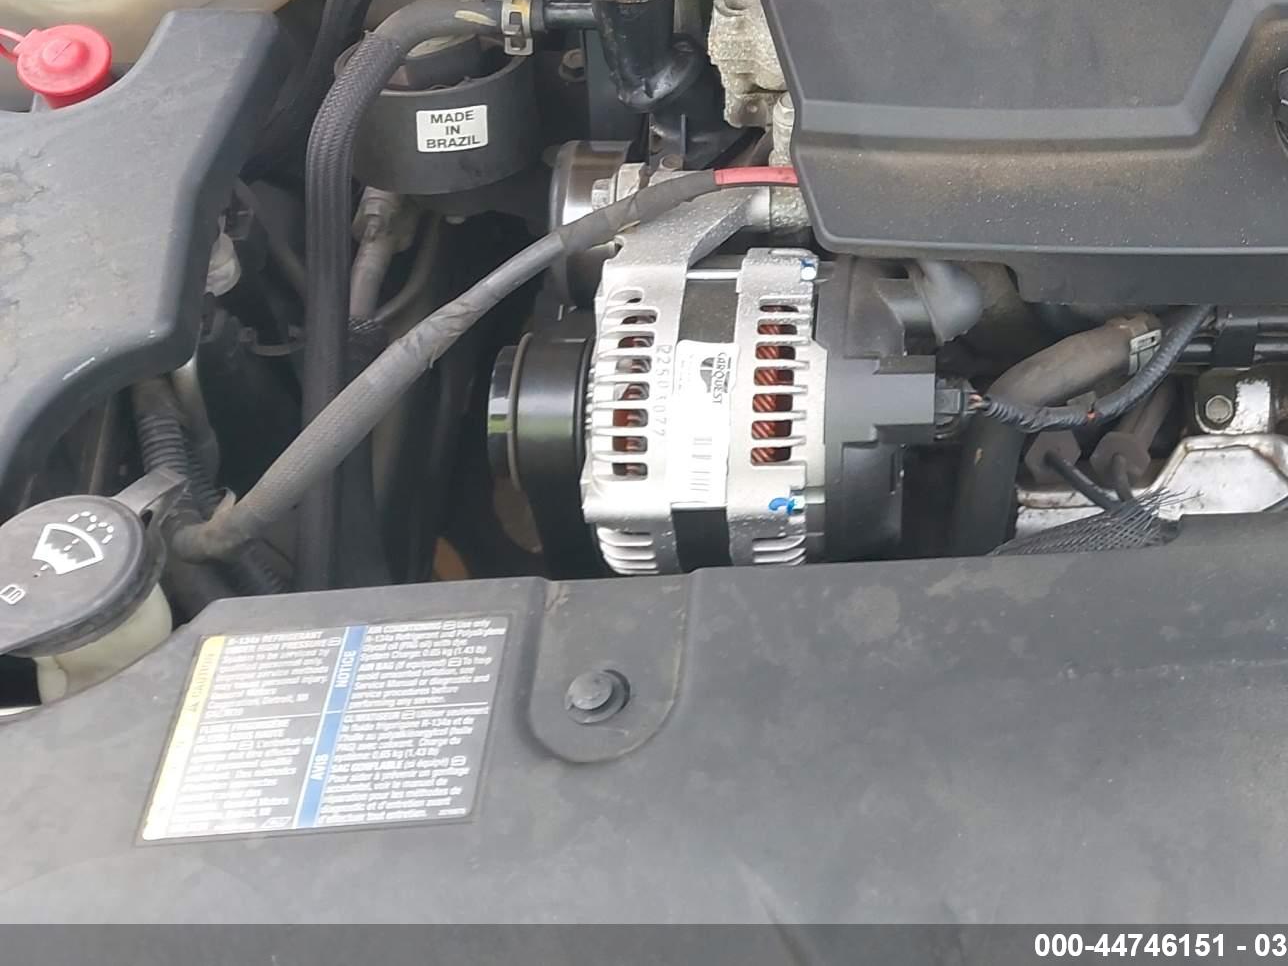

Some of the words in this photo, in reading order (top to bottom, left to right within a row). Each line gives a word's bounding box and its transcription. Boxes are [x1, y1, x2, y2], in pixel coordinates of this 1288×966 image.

[430, 110, 474, 124] MADE
[445, 125, 461, 135] IN
[426, 135, 480, 149] BRAZIL
[712, 352, 727, 405] CARQUEST
[335, 650, 357, 689] NOTICE
[311, 753, 330, 781] AVIS
